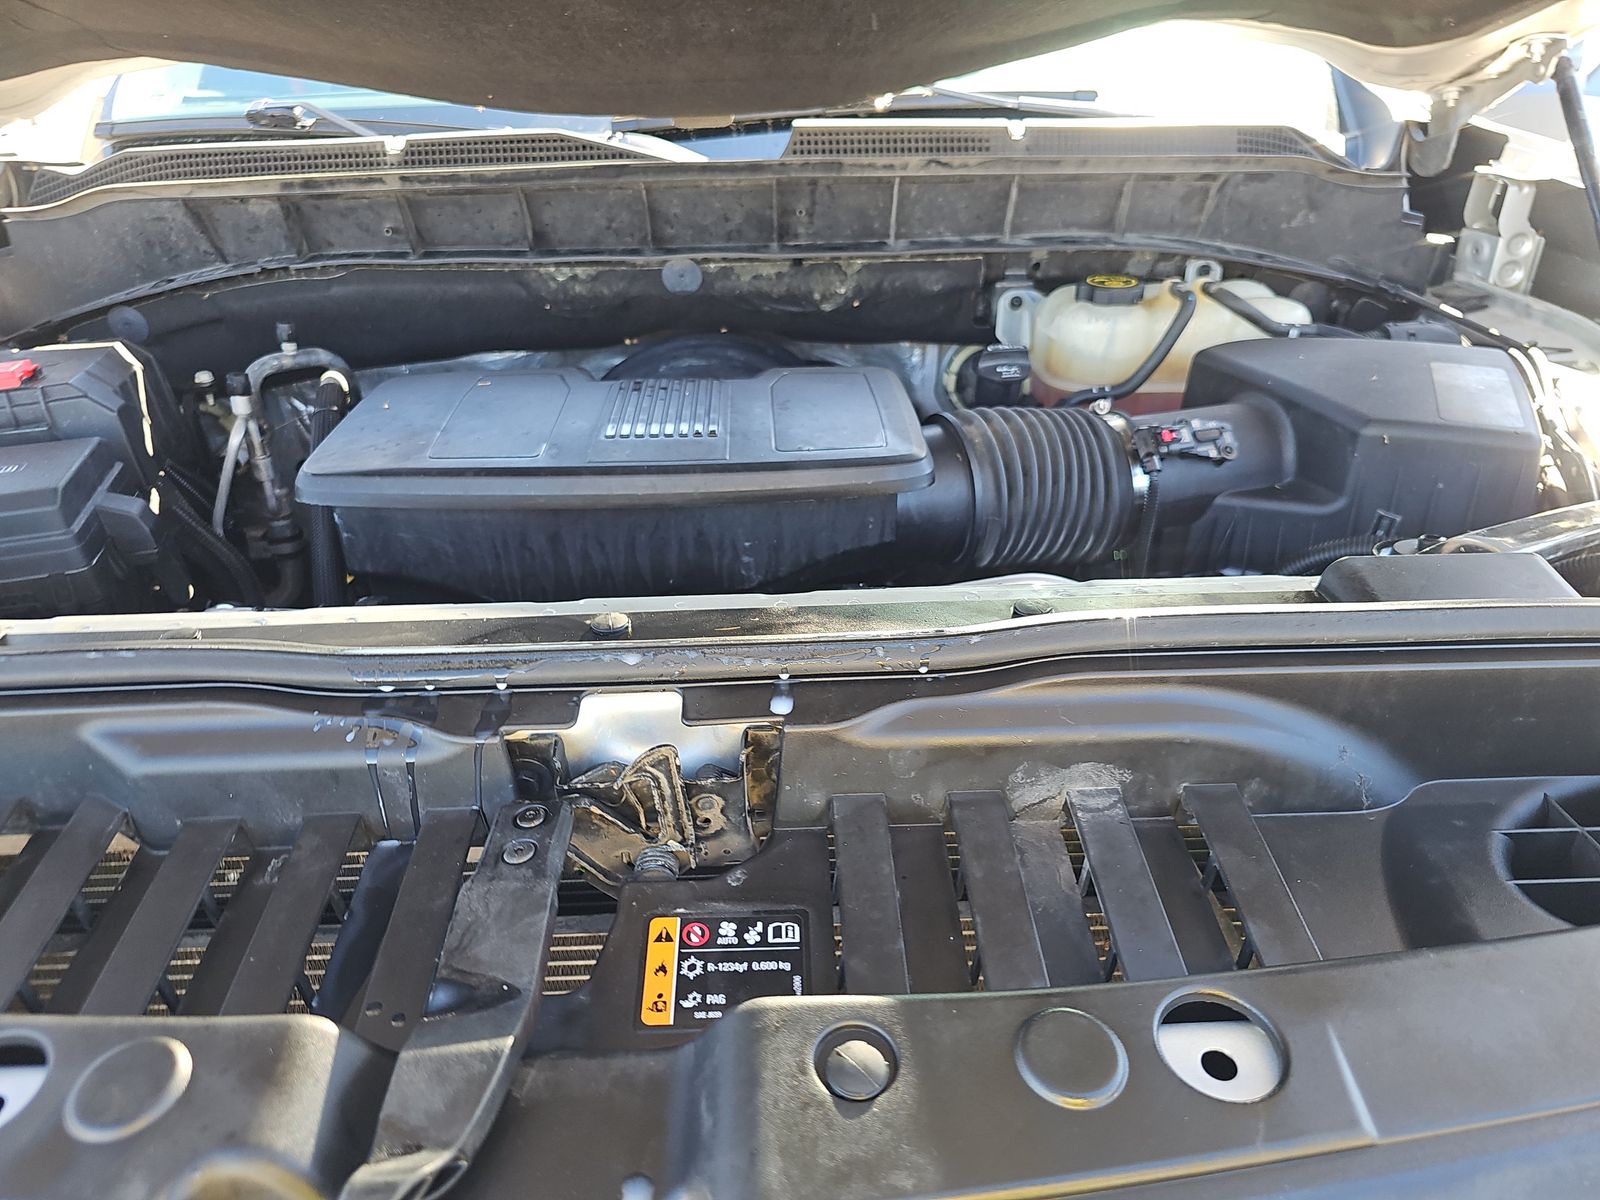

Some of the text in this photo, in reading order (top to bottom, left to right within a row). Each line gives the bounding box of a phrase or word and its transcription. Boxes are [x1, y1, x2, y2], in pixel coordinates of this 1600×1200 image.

[716, 936, 739, 945] AUTO
[706, 961, 748, 973] R-1234yf
[778, 960, 791, 971] kg
[705, 993, 726, 1005] PAG
